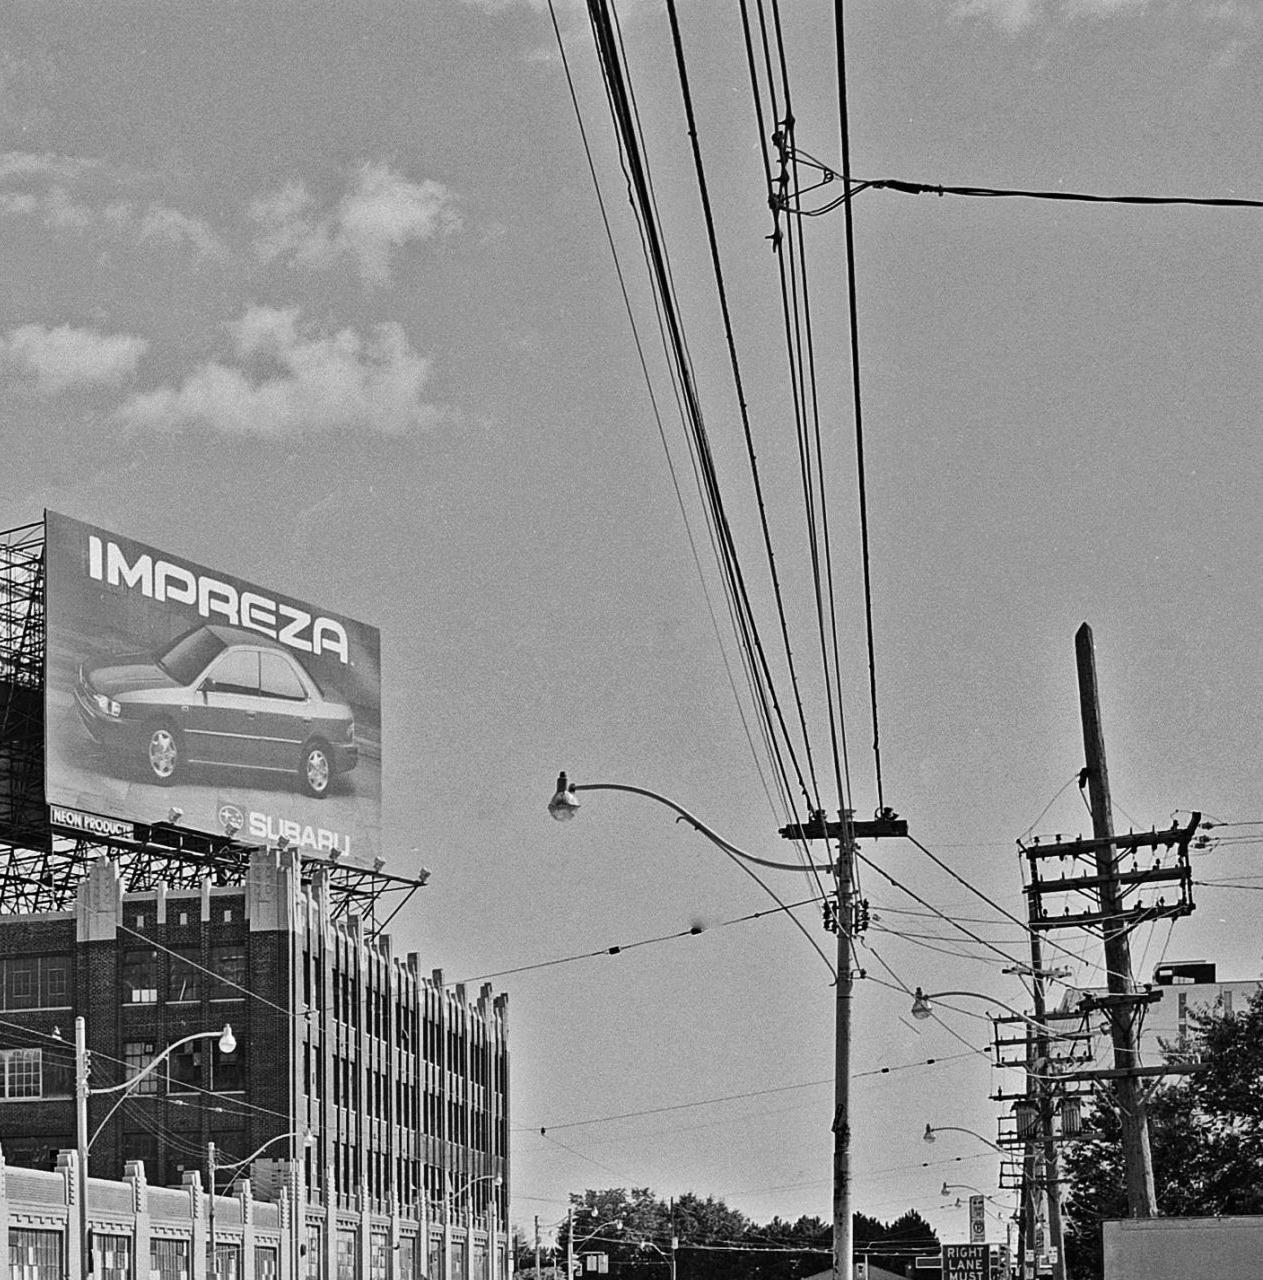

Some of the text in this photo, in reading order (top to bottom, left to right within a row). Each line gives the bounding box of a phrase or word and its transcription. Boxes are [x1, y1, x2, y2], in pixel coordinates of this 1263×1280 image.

[89, 535, 349, 664] IMPREZA
[53, 809, 82, 827] NEON
[249, 811, 350, 857] SUBARU
[947, 1247, 984, 1258] RIGHT
[949, 1259, 983, 1270] LANE
